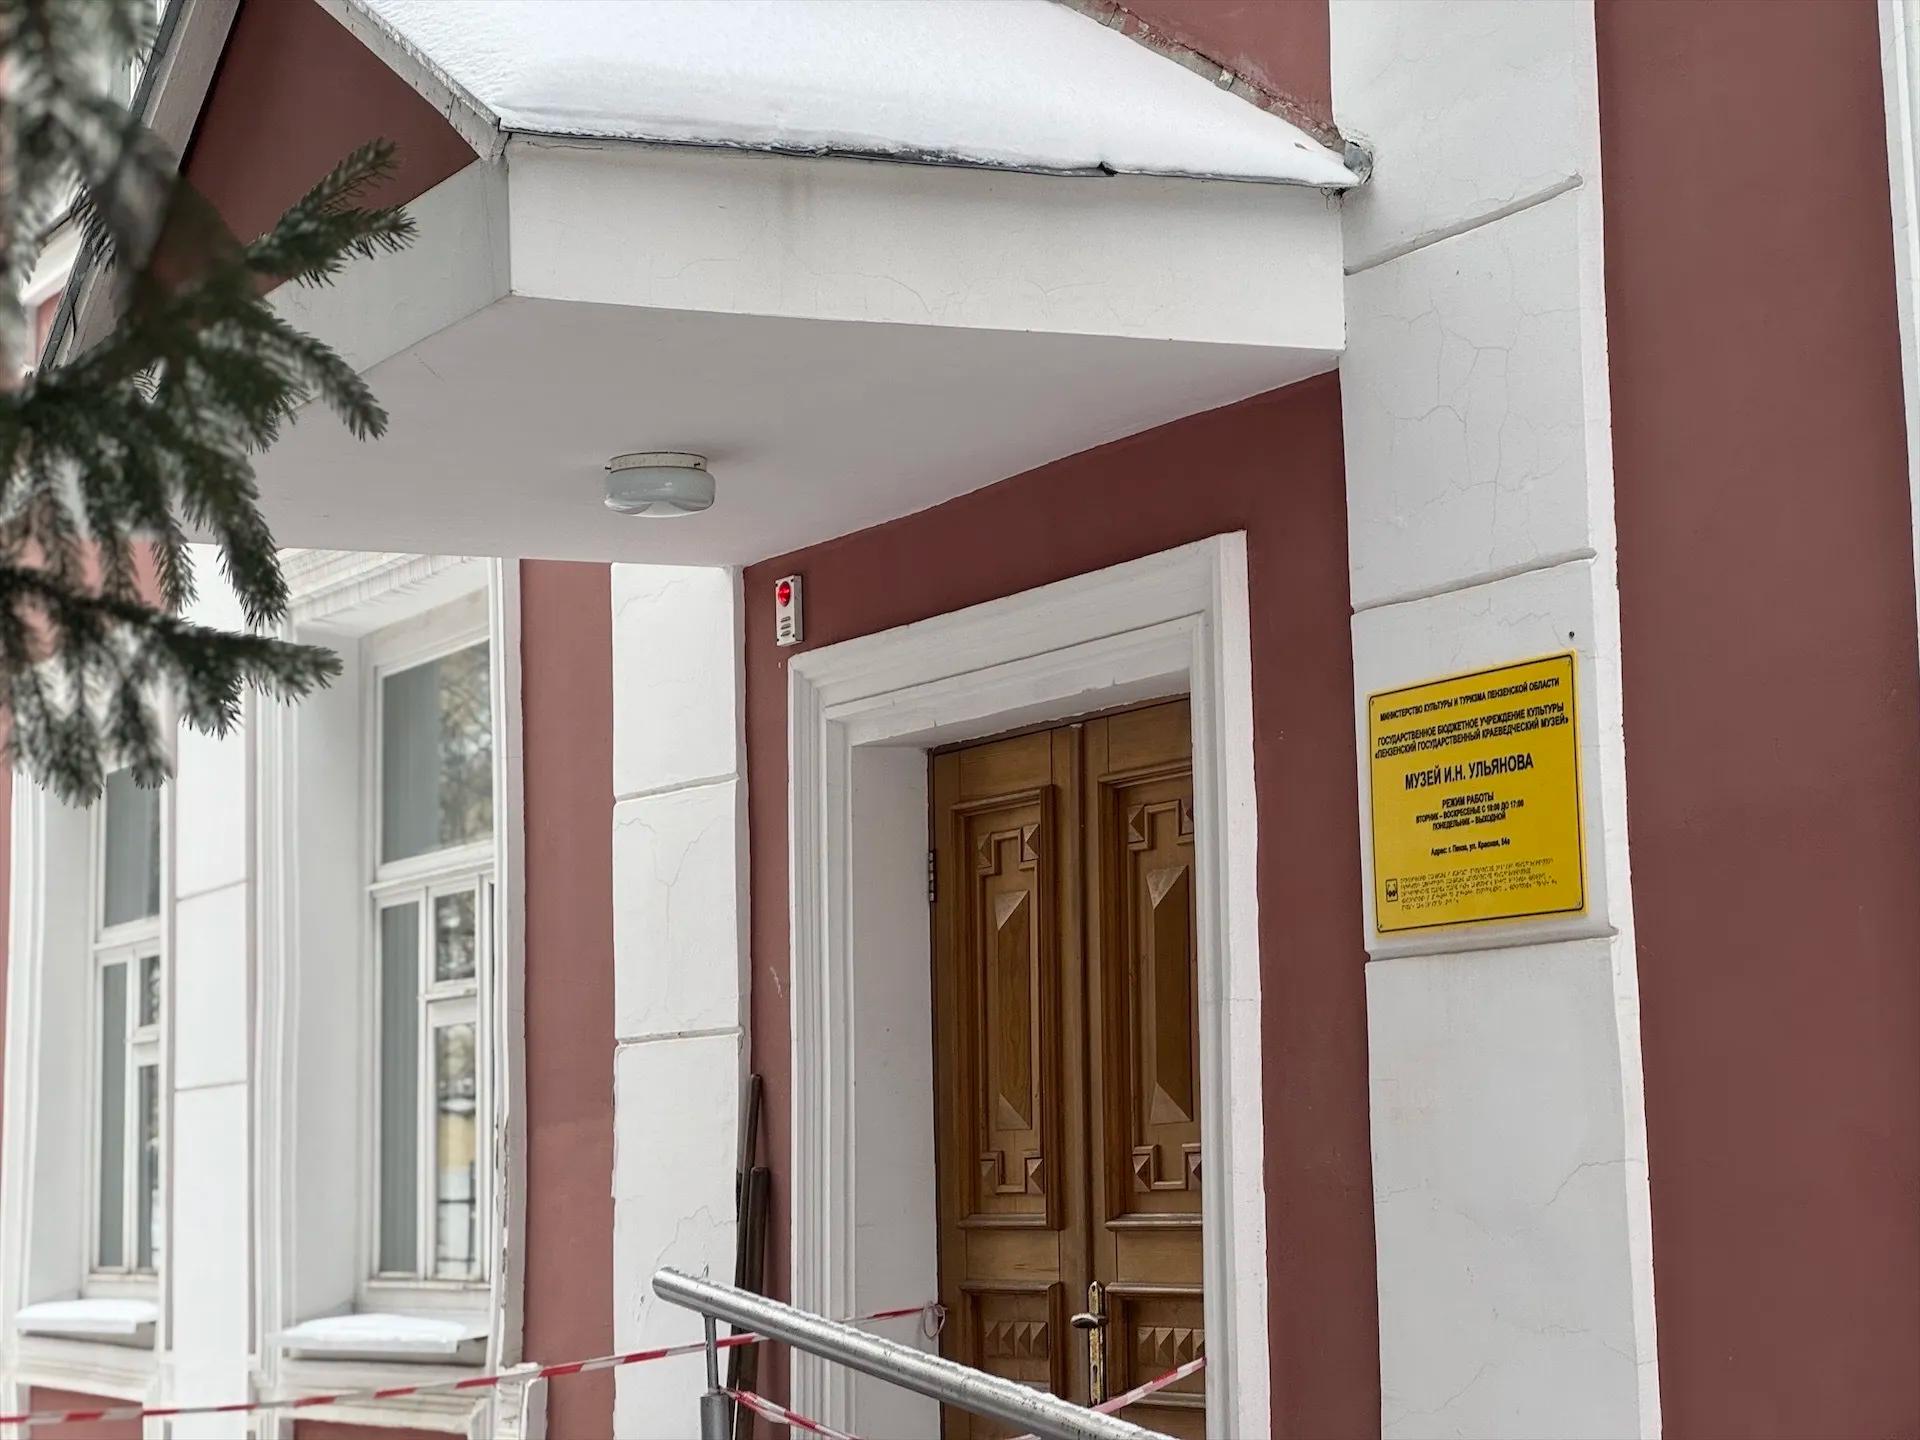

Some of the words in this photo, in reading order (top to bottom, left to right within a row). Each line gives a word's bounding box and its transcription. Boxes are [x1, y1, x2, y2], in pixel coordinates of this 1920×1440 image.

[1380, 705, 1423, 721] МИНИСТЕРСТВО
[1424, 700, 1453, 713] КУЛЬТУРЫ
[1488, 682, 1528, 699] ПЕНЗЕНСКОЙ
[1529, 678, 1559, 691] ОБЛАСТИ
[1375, 741, 1416, 759] «ПЕНЗЕНСКИЙ
[1418, 730, 1480, 751] ГОСУДАРСТВЕННЫЙ
[1482, 718, 1539, 739] КРАЕВЕДЧЕСКИЙ
[1541, 713, 1568, 727] МУЗЕЙ»
[1378, 726, 1436, 745] ГОСУДАРСТВЕННОЕ
[1438, 719, 1479, 735] БЮДЖЕТНОЕ
[1480, 710, 1525, 727] УЧРЕЖДЕНИЕ
[1527, 702, 1564, 717] КУЛЬТУРЫ
[1405, 765, 1441, 790] МУЗЕЙ
[1444, 764, 1466, 782] И.Н.
[1469, 753, 1534, 779] УЛЬЯНОВА
[1416, 813, 1438, 823] ВТОРНИК
[1444, 806, 1480, 819] ВОСКРЕСЕНЬЕ
[1501, 802, 1509, 811] ДО
[1442, 796, 1465, 809] РЕЖИМ
[1466, 792, 1494, 805] РАБОТЫ
[1433, 819, 1470, 831] ПОНЕДЕЛЬНИК
[1475, 811, 1506, 824] ВЫХОДНОЙ
